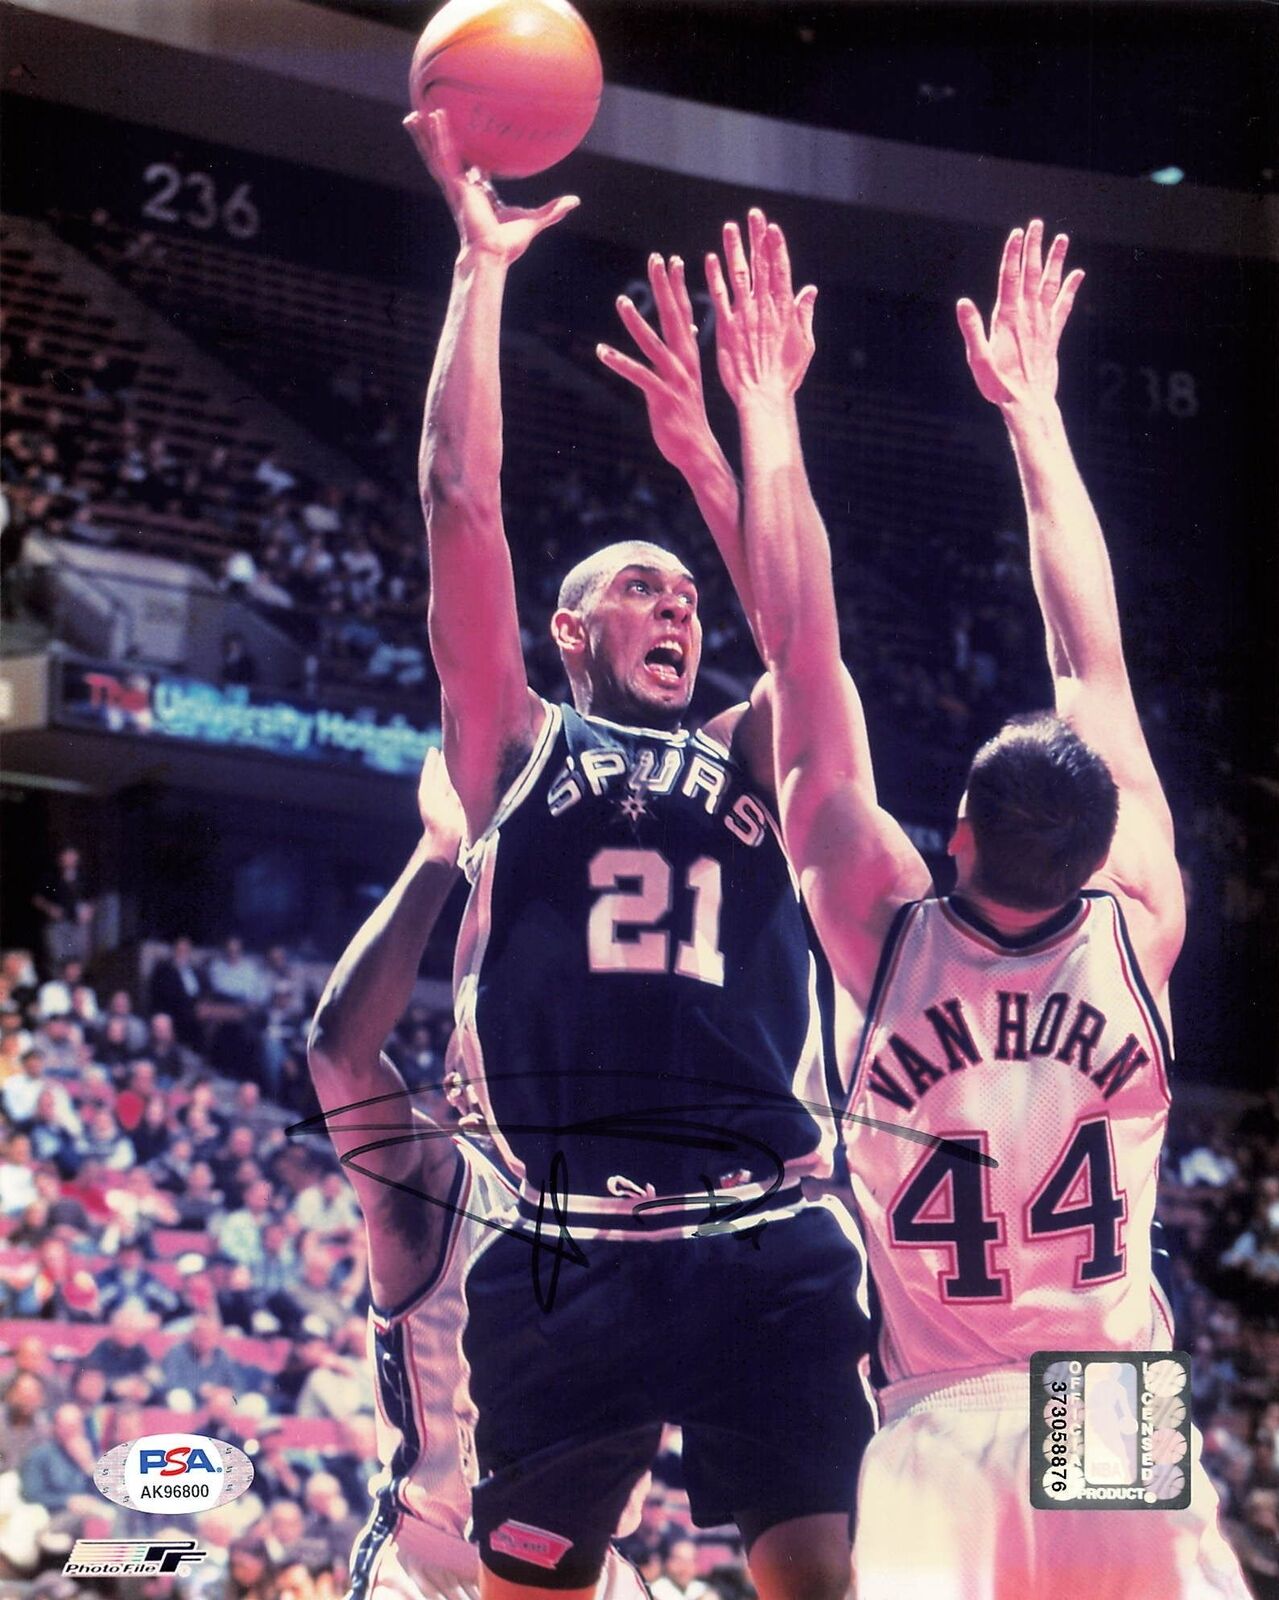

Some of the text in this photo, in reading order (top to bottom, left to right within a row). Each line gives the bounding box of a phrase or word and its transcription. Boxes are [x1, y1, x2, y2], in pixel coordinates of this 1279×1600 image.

[143, 163, 259, 239] 236
[548, 747, 768, 848] SPURS
[587, 847, 725, 988] 21
[866, 990, 1151, 1114] VAN HORN
[886, 1110, 1129, 1306] 44
